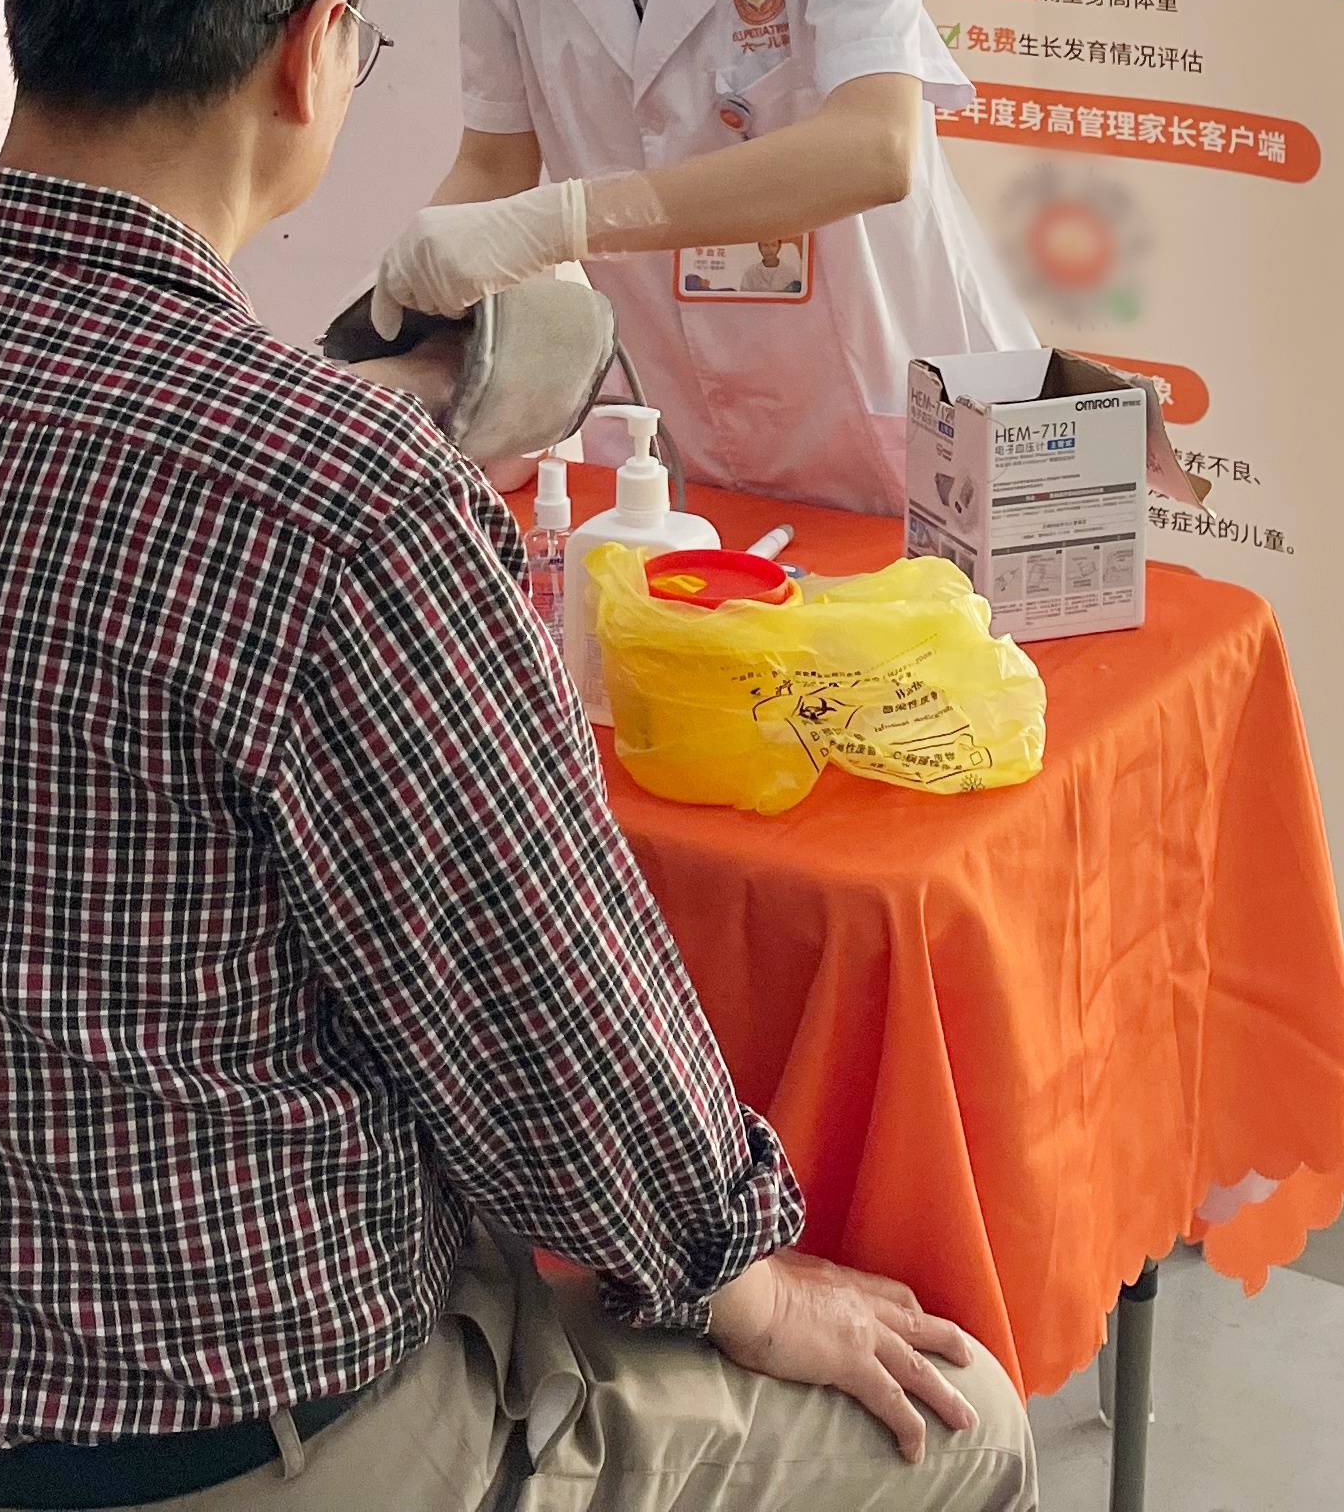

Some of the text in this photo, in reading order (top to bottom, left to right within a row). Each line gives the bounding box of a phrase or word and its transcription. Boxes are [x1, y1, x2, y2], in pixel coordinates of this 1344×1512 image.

[966, 24, 1205, 75] 免费生长发育情况评估
[995, 420, 1077, 444] HEM-7121
